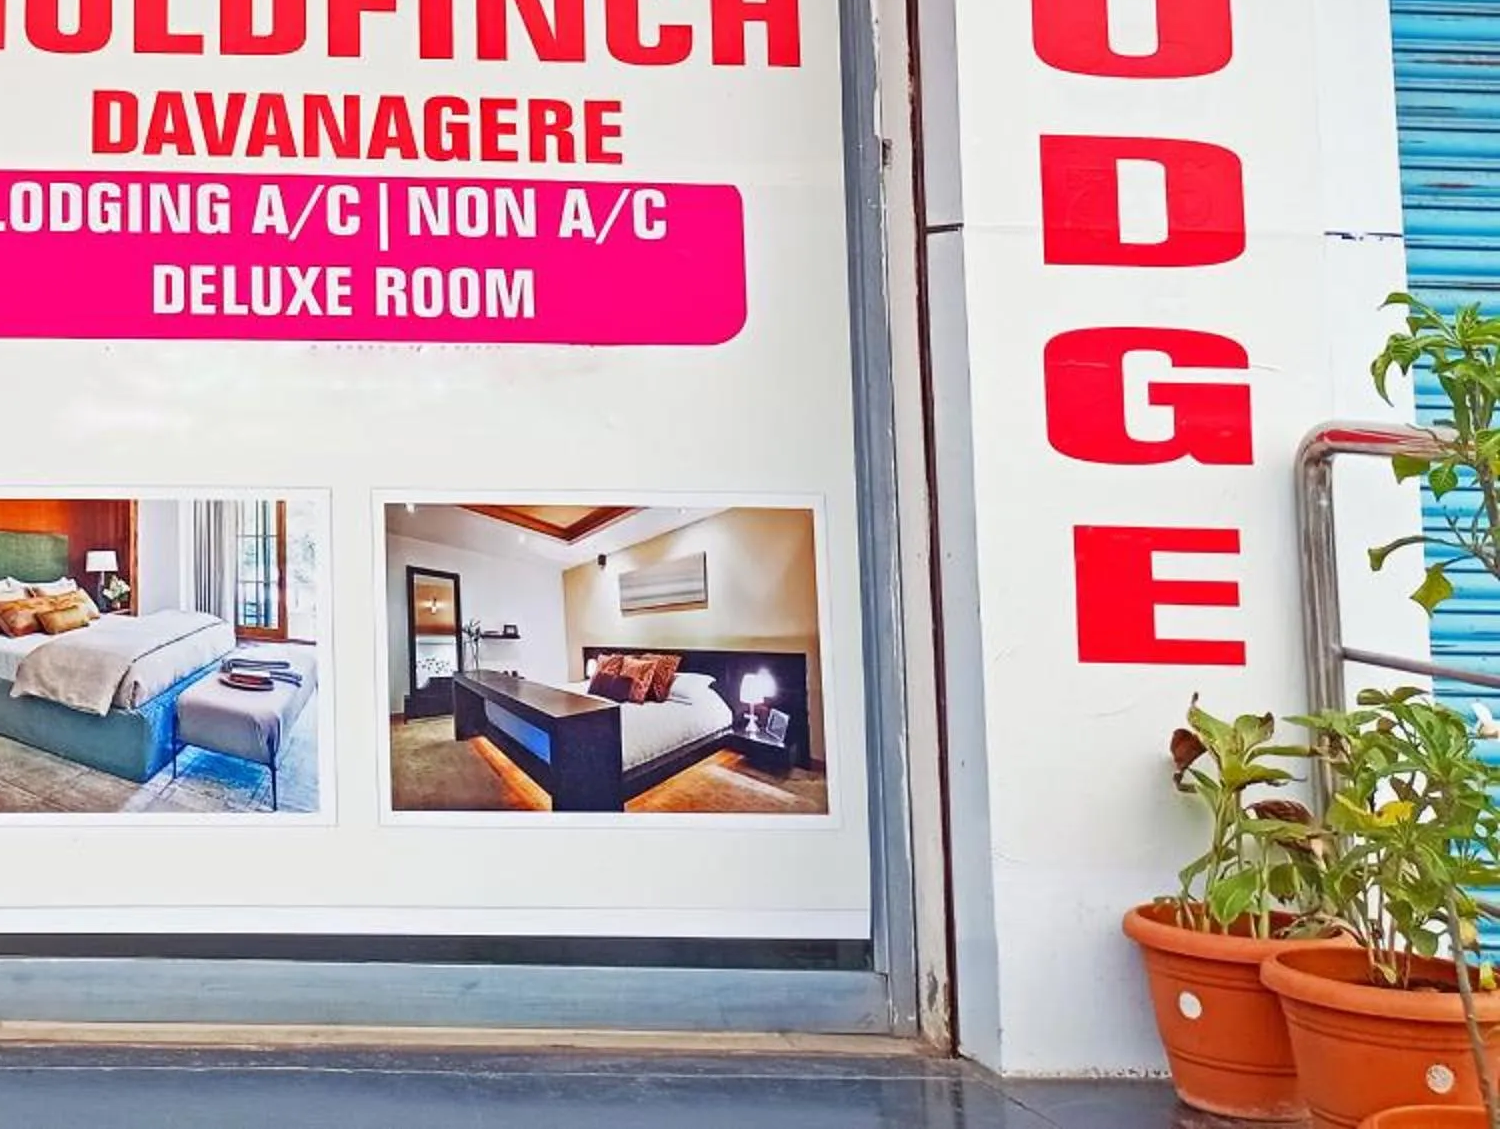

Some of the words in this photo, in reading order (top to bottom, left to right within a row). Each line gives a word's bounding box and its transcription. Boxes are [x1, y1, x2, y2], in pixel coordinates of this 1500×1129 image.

[92, 90, 623, 165] DAVANAGERE
[251, 183, 361, 240] A/C
[407, 185, 537, 239] NON
[558, 187, 667, 244] A/C
[152, 263, 353, 317] DELUXE
[375, 267, 536, 319] ROOM
